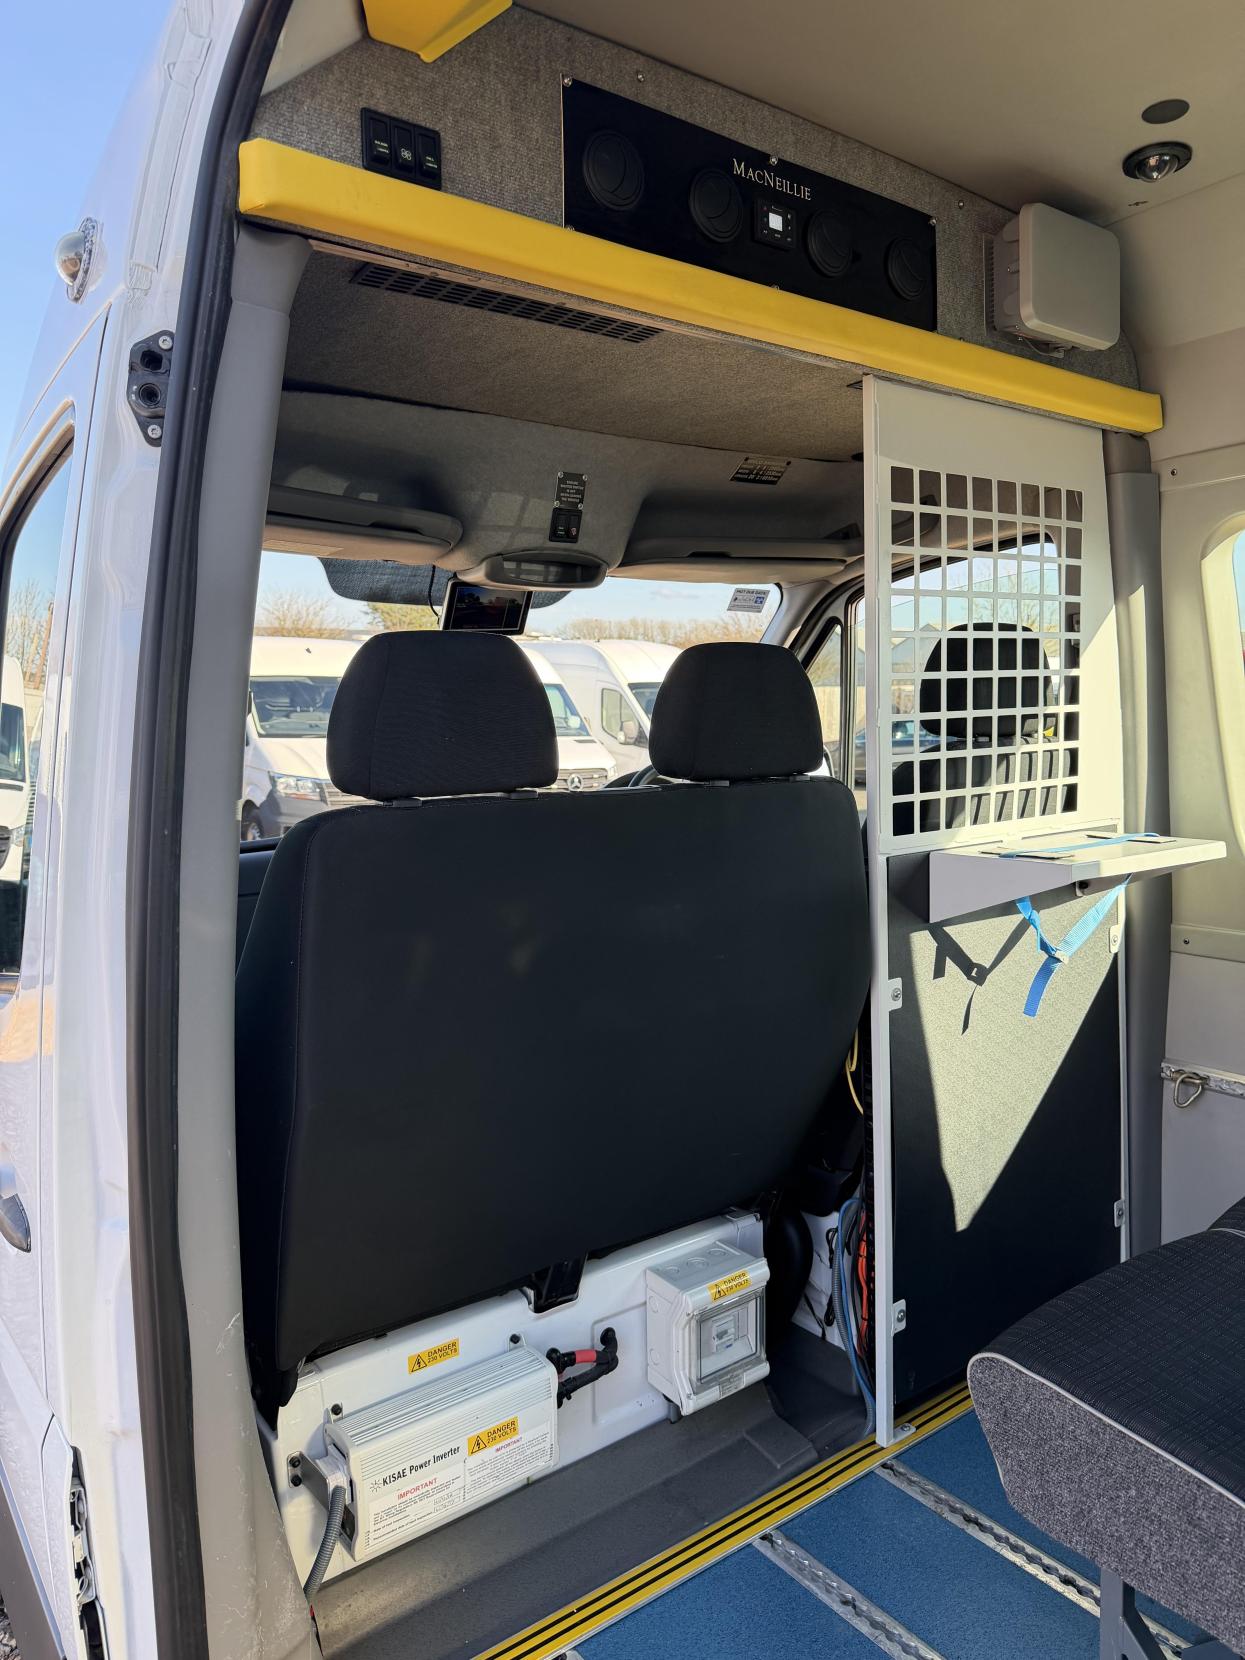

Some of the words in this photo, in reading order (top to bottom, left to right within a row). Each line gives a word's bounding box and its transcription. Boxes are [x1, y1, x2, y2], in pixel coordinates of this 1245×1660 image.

[724, 1272, 747, 1287] DANGER
[427, 1341, 457, 1358] DANGER
[427, 1355, 438, 1364] 230
[438, 1347, 458, 1359] VOLTS
[487, 1420, 516, 1438] DANGER
[497, 1427, 517, 1439] VOLTS
[382, 1468, 407, 1486] KISAE
[409, 1459, 432, 1475] Power
[432, 1446, 460, 1464] Inverter
[397, 1477, 438, 1500] IMPORTANT
